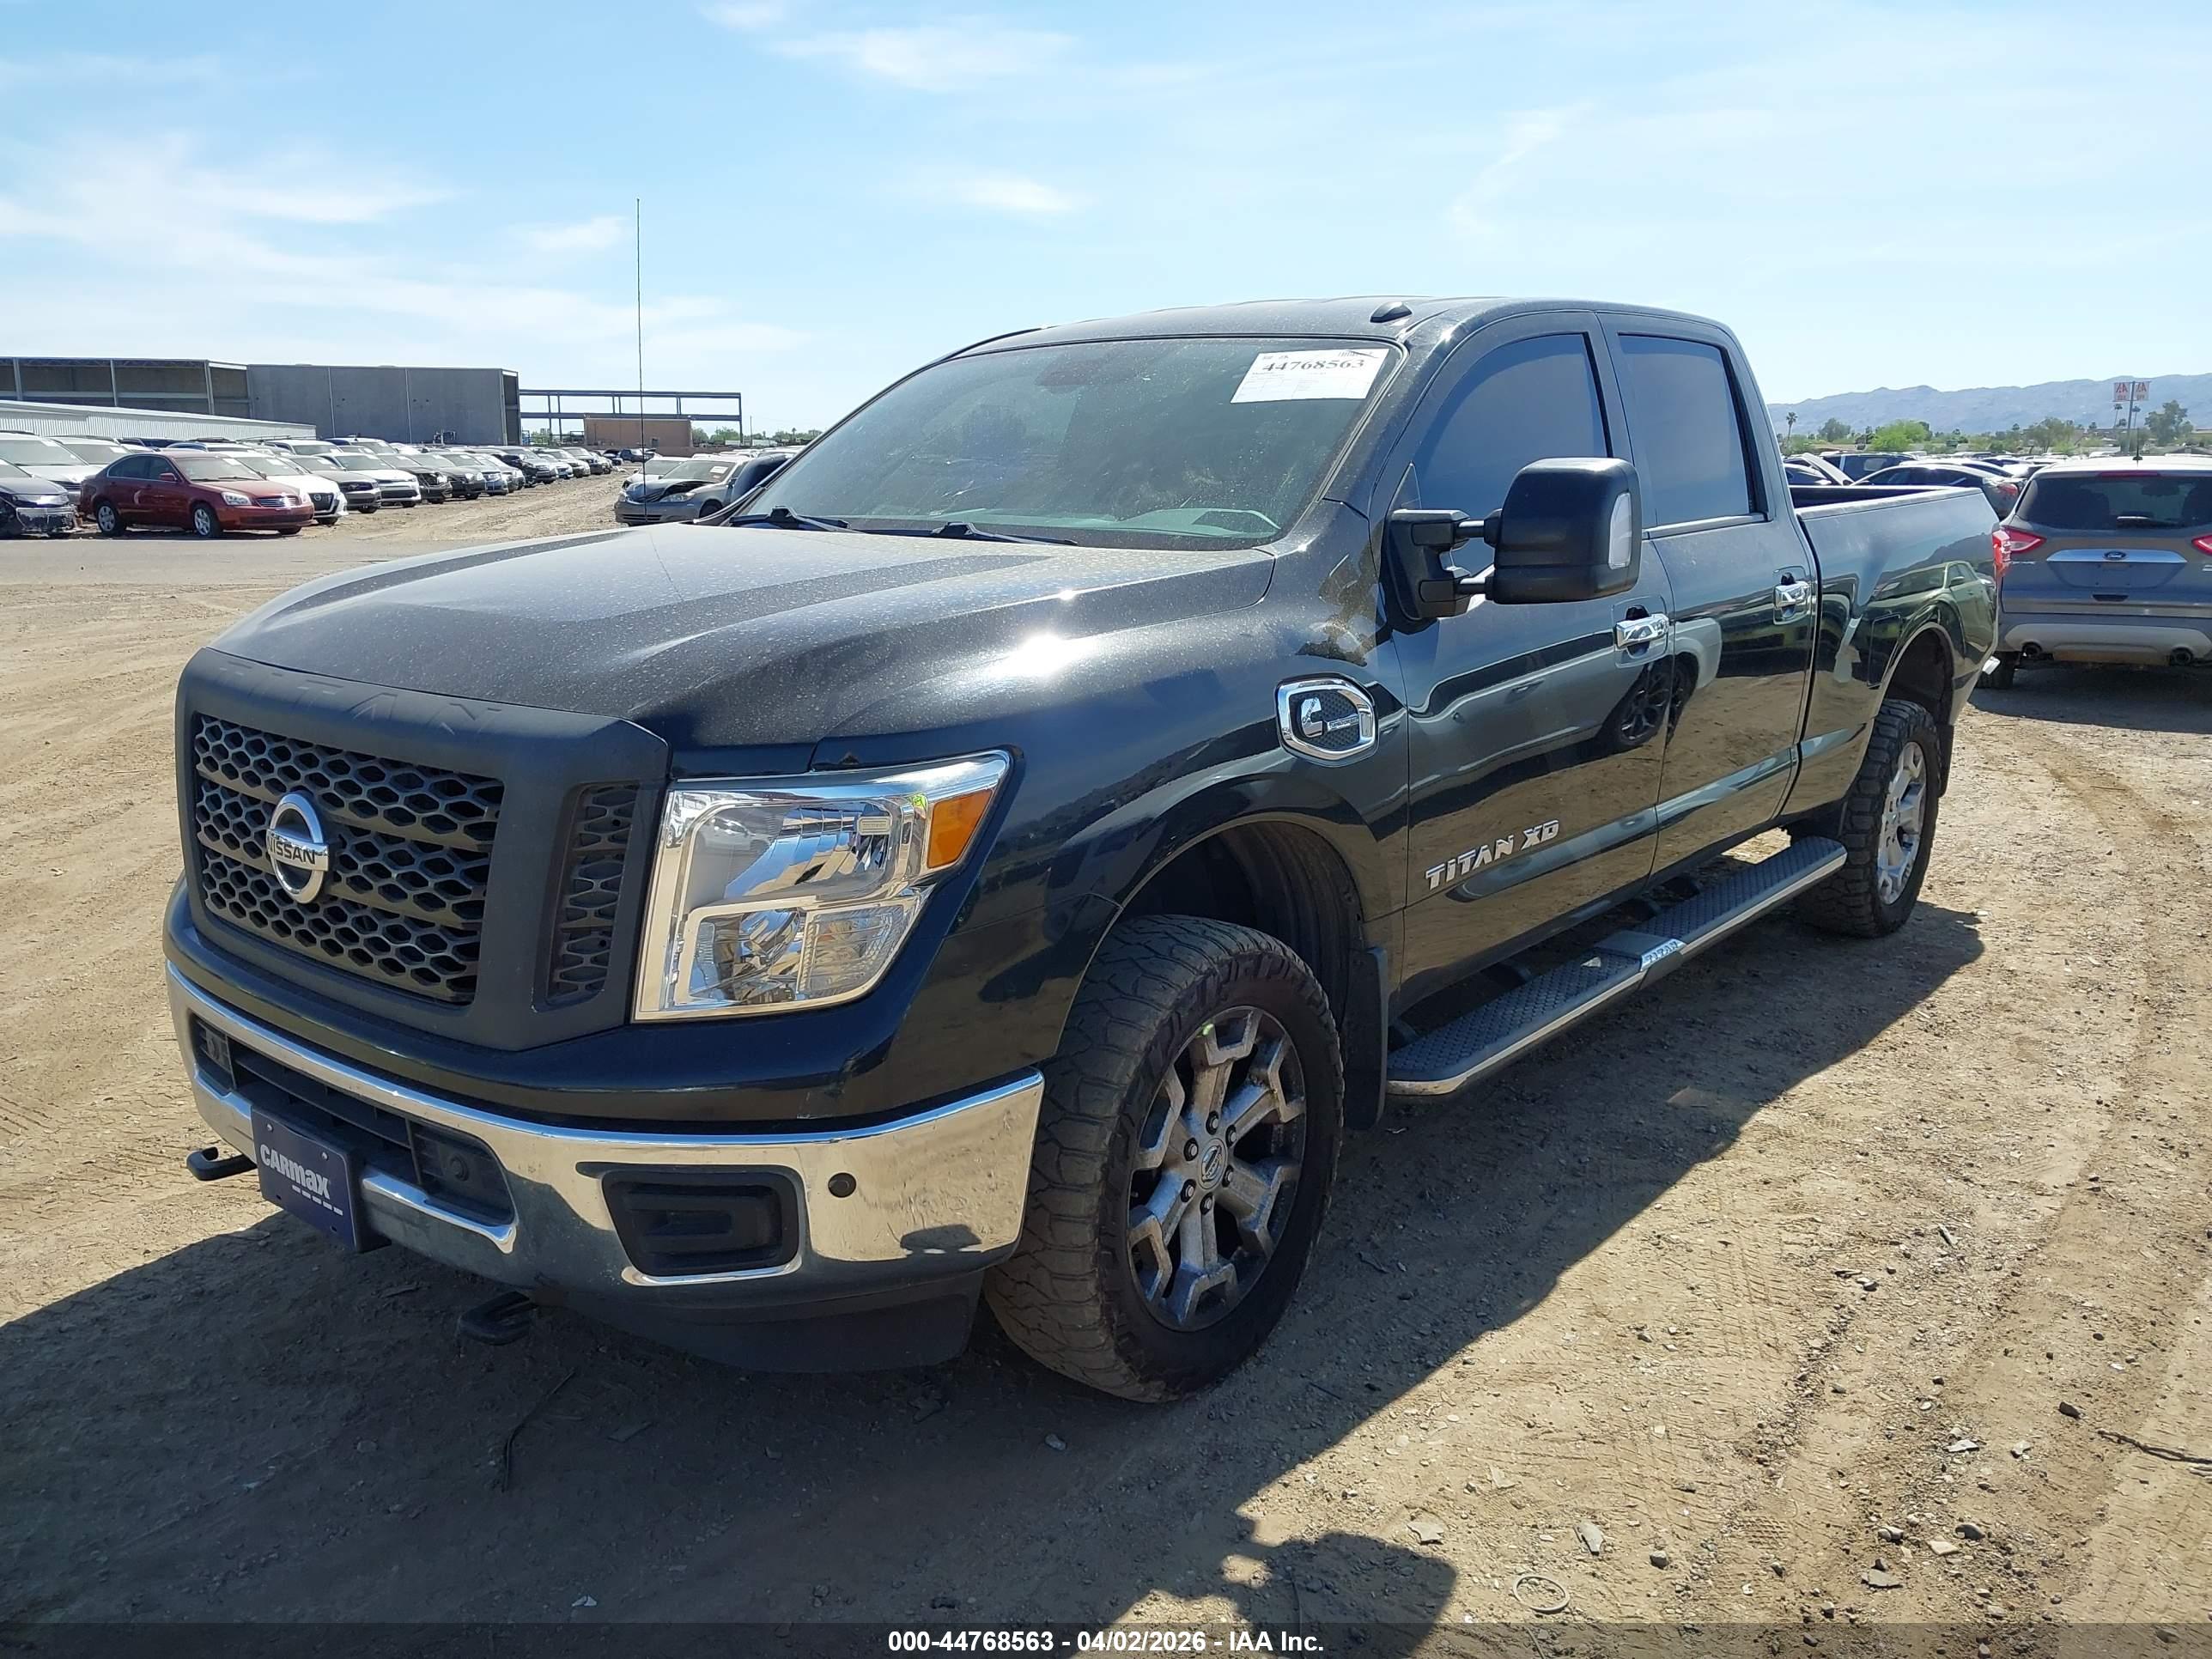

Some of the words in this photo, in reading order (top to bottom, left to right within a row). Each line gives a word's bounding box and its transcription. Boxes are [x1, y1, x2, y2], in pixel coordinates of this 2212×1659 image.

[1262, 360, 1364, 371] 44768563
[267, 835, 315, 865] NISSAN
[1425, 835, 1514, 890] TITAN
[1522, 820, 1559, 850] XD
